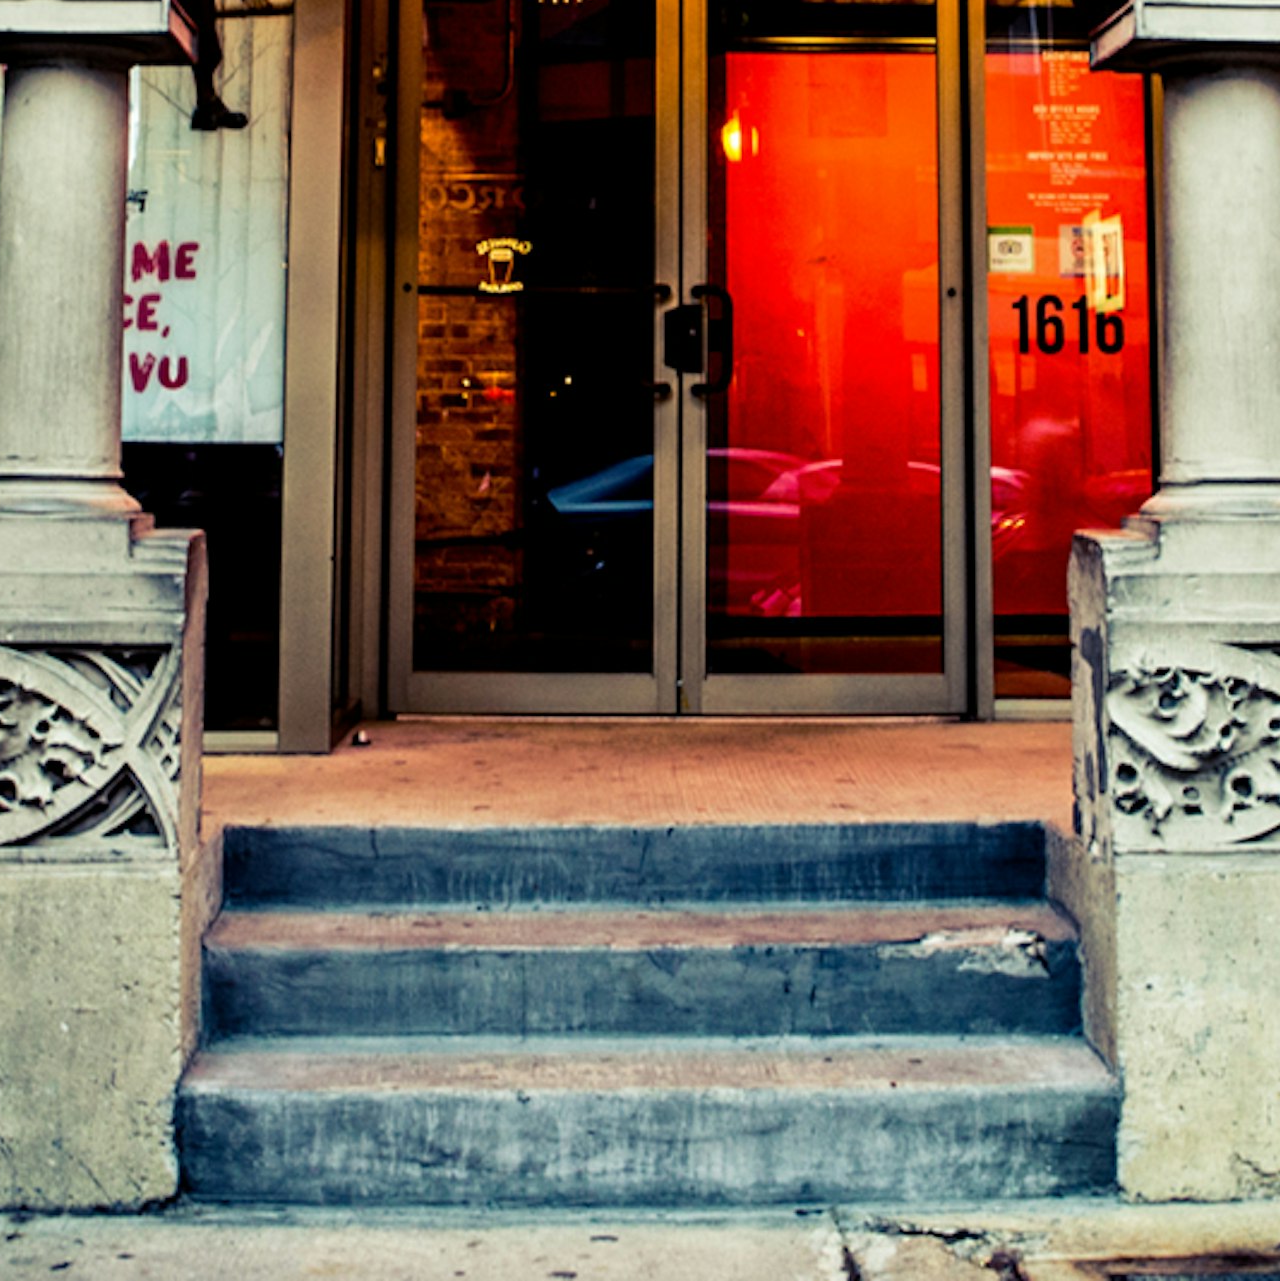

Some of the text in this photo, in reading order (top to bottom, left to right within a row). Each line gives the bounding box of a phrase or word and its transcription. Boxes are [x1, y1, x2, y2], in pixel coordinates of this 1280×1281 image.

[131, 239, 200, 283] ME
[1012, 294, 1125, 355] 1616
[129, 352, 189, 394] VU
